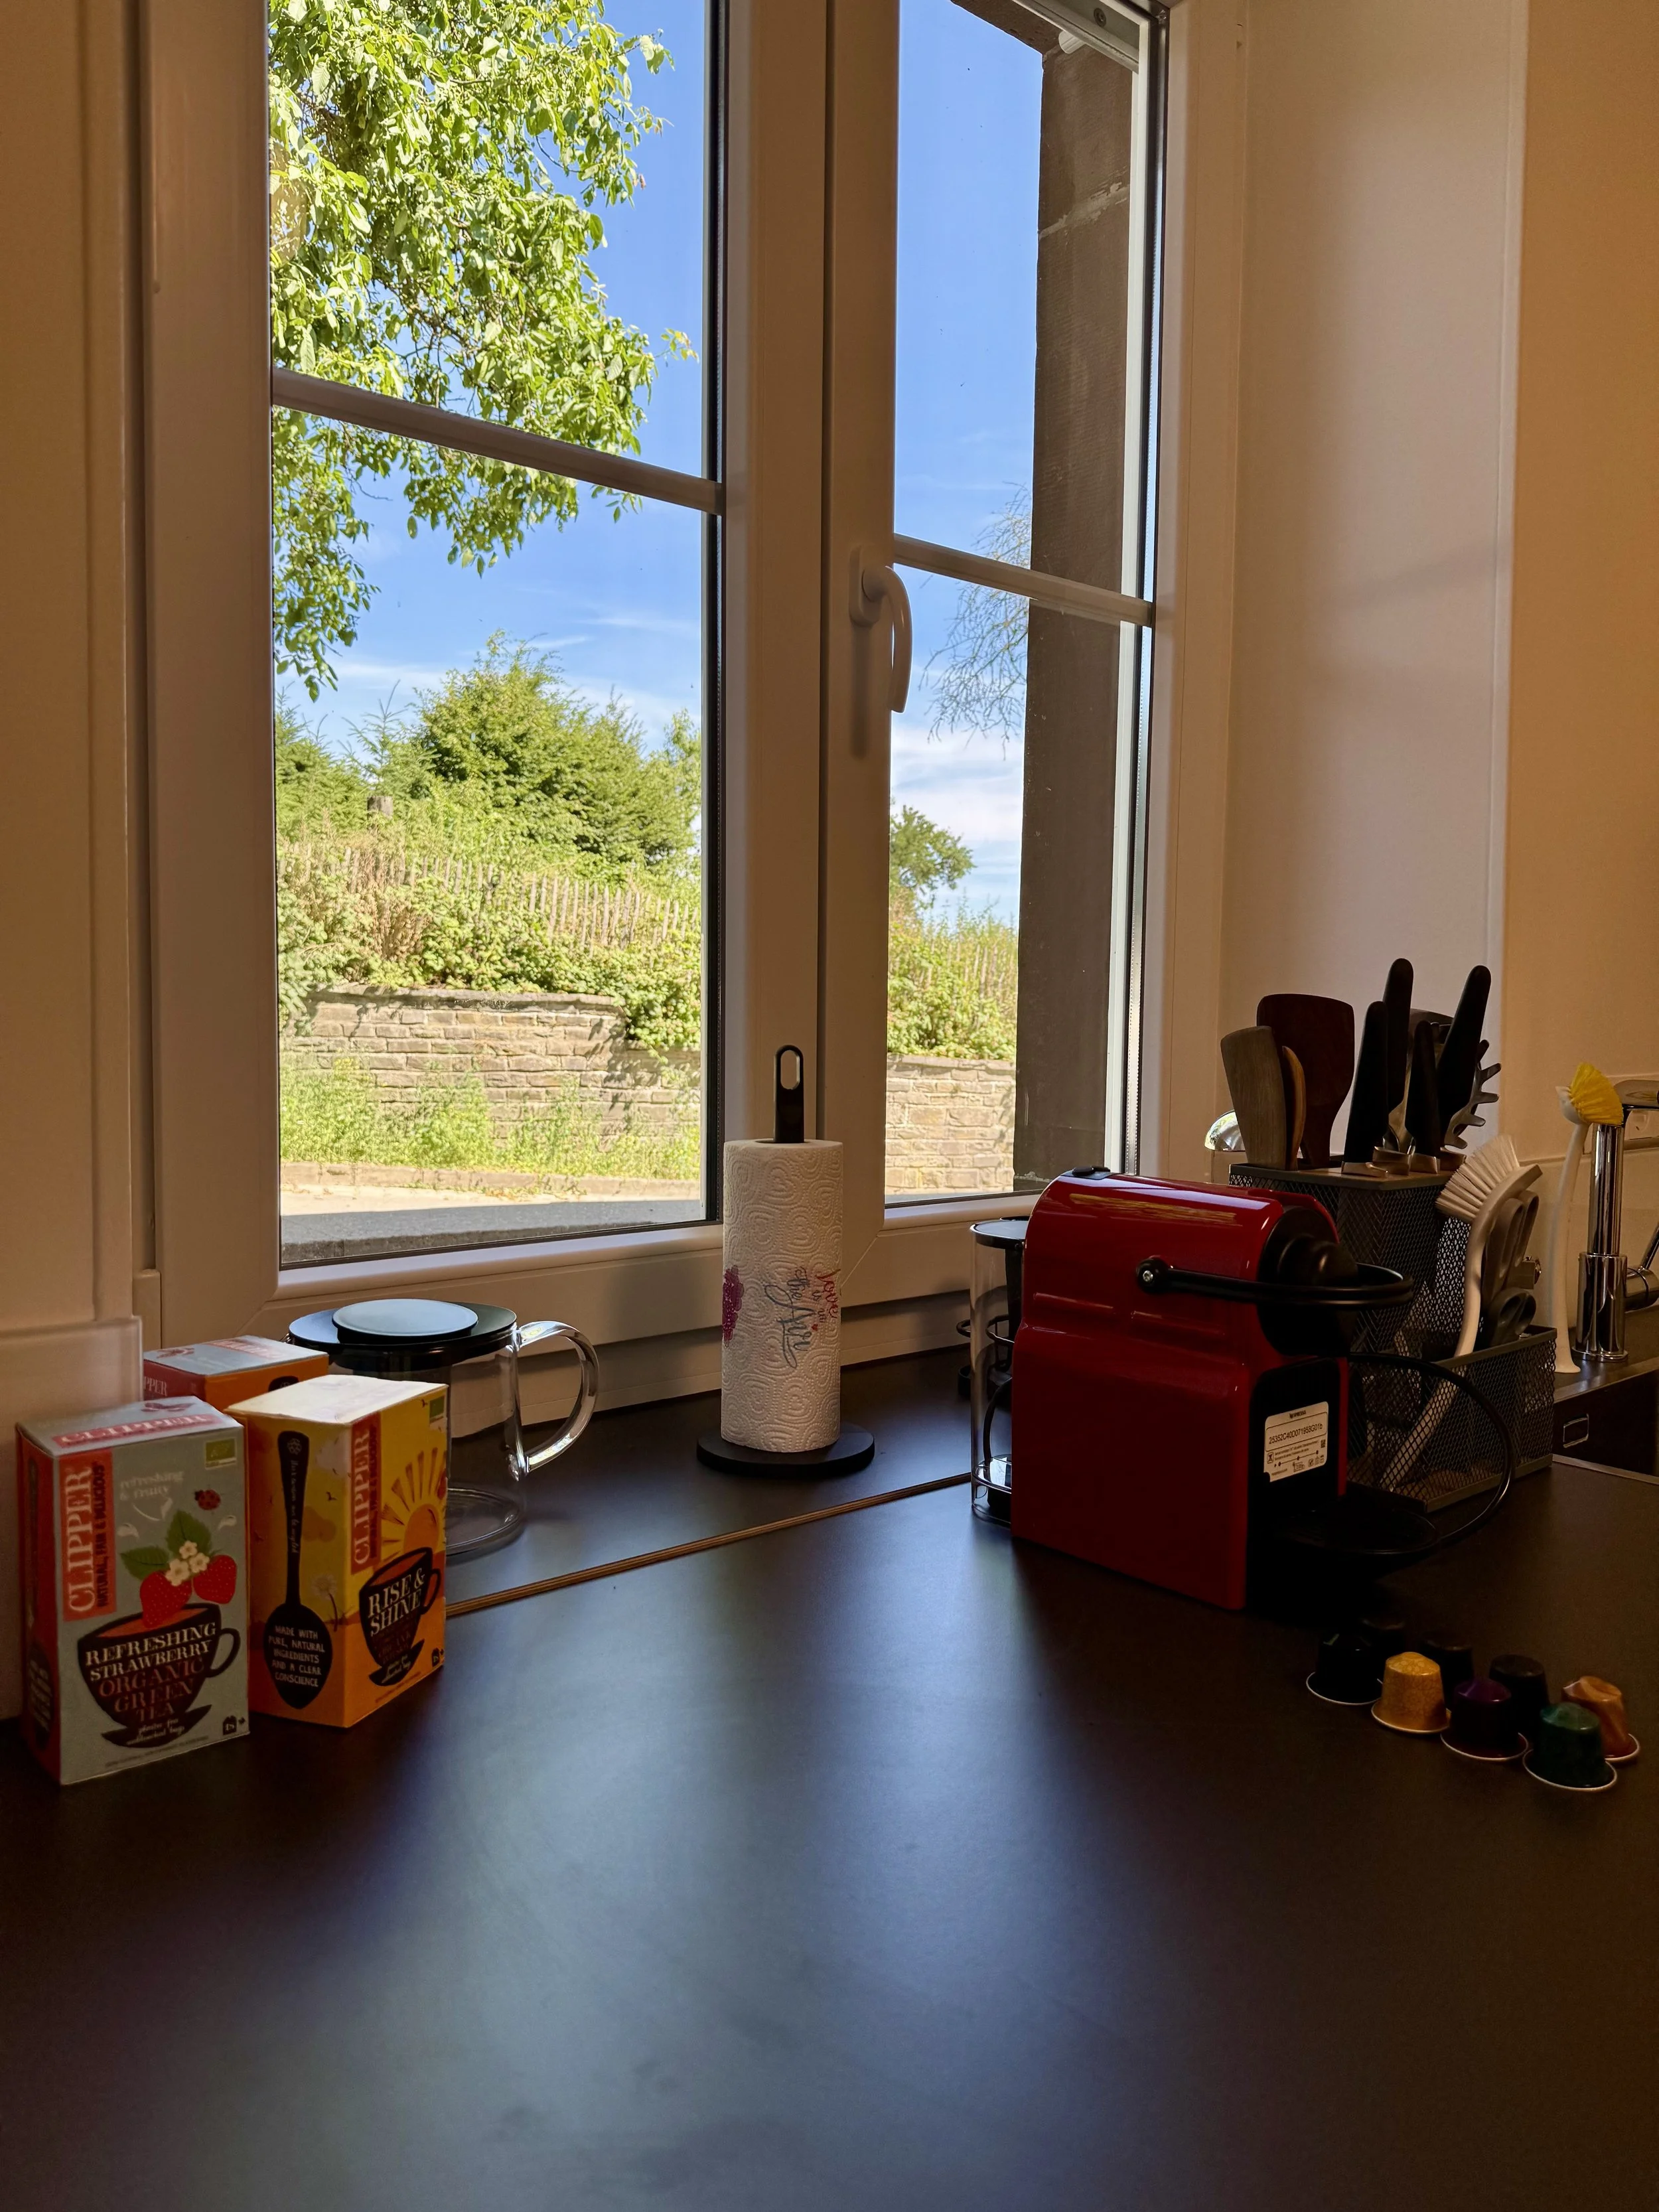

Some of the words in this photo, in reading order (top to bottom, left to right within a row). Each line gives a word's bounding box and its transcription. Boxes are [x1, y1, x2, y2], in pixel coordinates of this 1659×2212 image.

[765, 1284, 817, 1369] Air
[144, 1376, 167, 1396] PPER
[60, 1414, 210, 1443] CLIPPER
[353, 1429, 370, 1565] CLIPPER
[66, 1467, 96, 1612] CLIPPER
[368, 1574, 411, 1618] RISE
[413, 1567, 425, 1589] &
[369, 1588, 422, 1637] SHINE
[85, 1621, 216, 1666] REFRESHING
[274, 1625, 295, 1637] MADE
[298, 1629, 319, 1641] WITH
[291, 1639, 326, 1653] NATURAL
[89, 1639, 213, 1682] STRAWBERRY
[271, 1659, 287, 1670] AND
[289, 1662, 295, 1672] A
[299, 1664, 323, 1676] CLEAR
[273, 1649, 320, 1664] INGREDIENTS
[99, 1657, 205, 1698] ORGANIC
[274, 1671, 319, 1688] CONSCIENCE
[113, 1678, 194, 1713] GREEN
[135, 1702, 175, 1722] TEA
